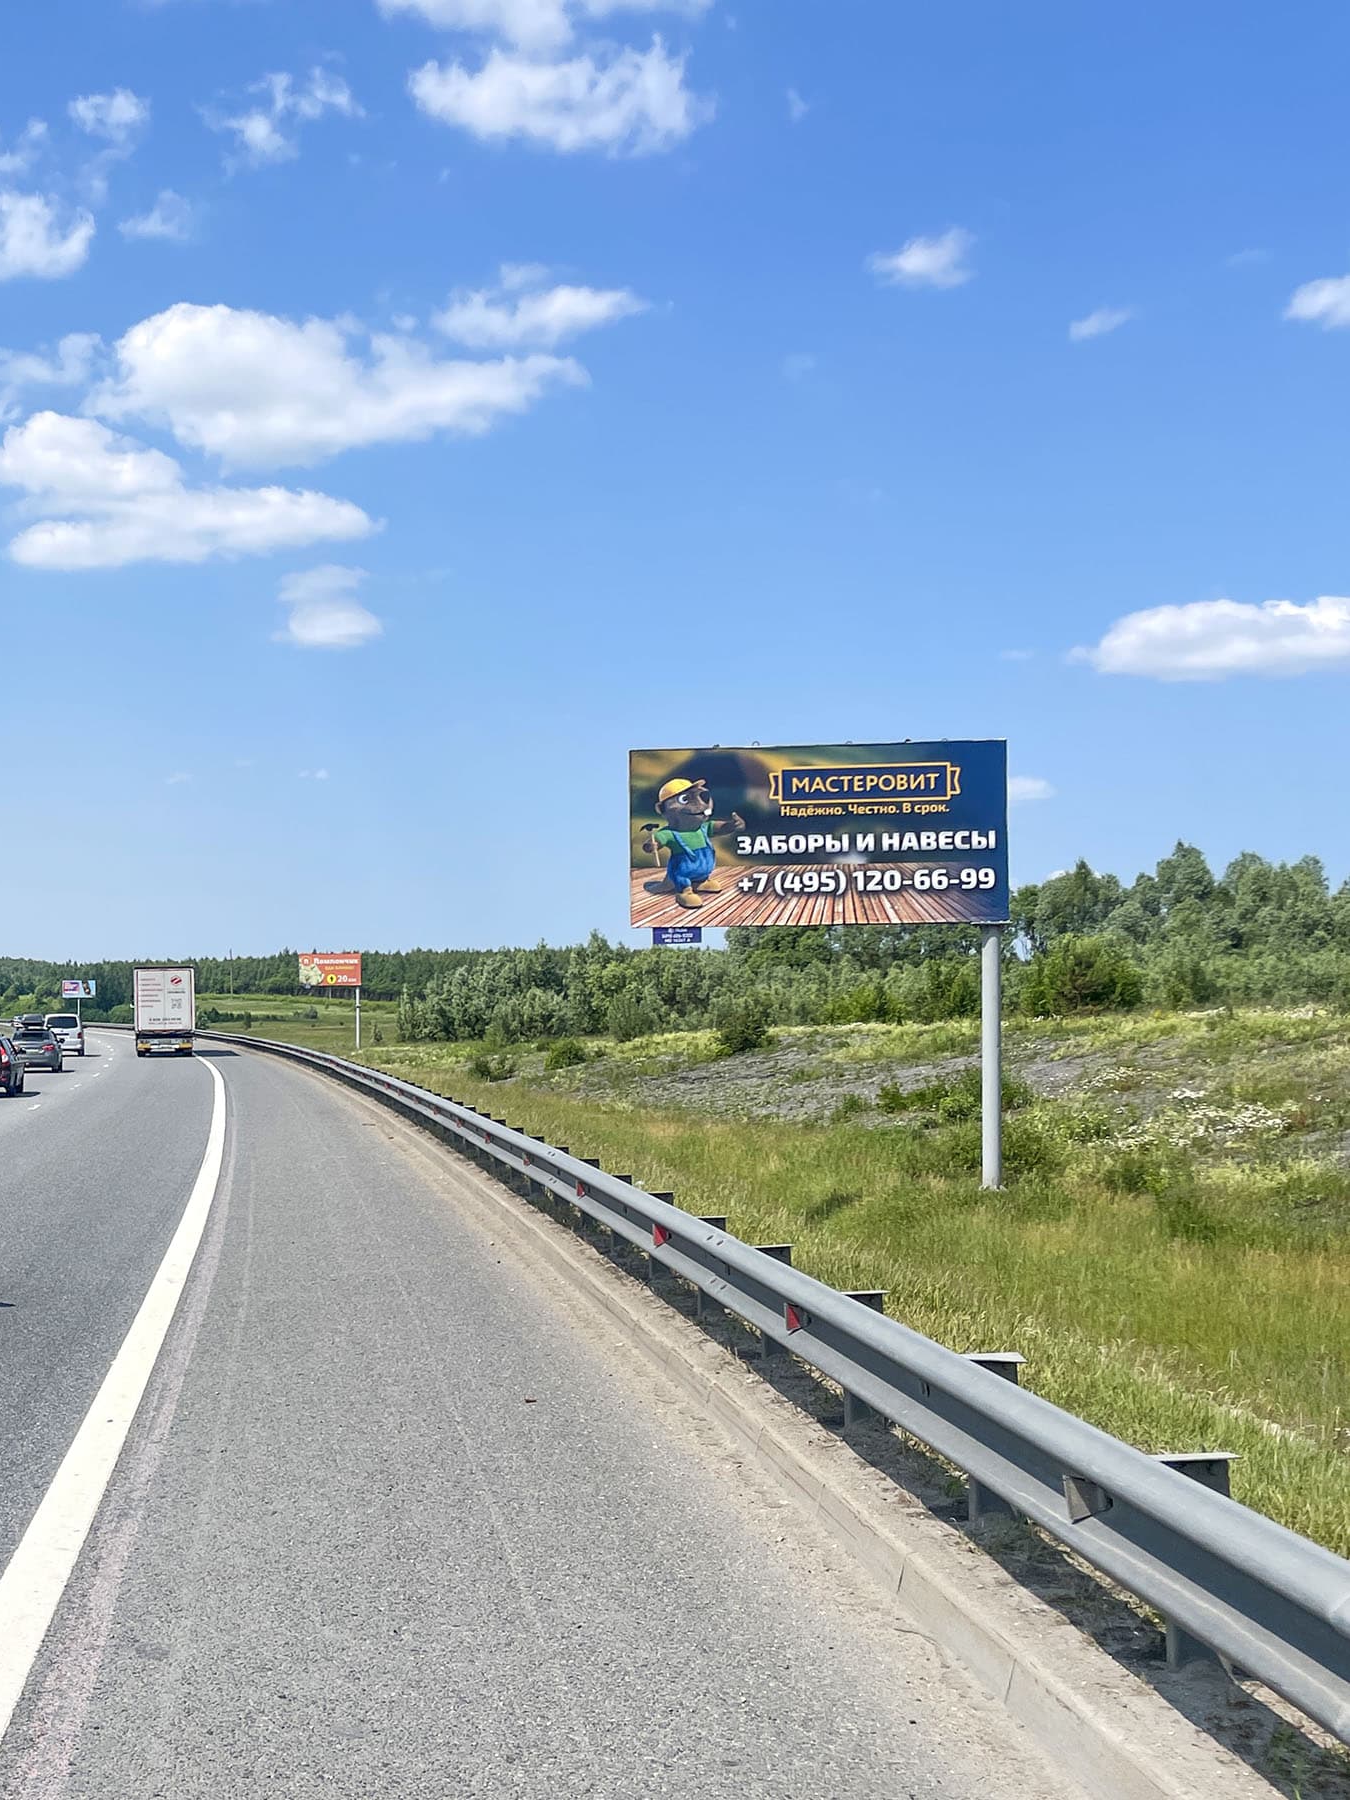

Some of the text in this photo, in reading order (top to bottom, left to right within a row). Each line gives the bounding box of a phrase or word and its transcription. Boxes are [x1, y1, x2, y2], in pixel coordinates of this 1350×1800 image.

[791, 773, 939, 794] МАСТЕРОВИТ
[780, 802, 950, 818] Надёжно. Честно. В срок.
[736, 830, 996, 855] ЗАБОРЫ И НАВЕСЫ
[738, 867, 996, 896] +7 (495) 120-66-99
[337, 974, 348, 983] 20
